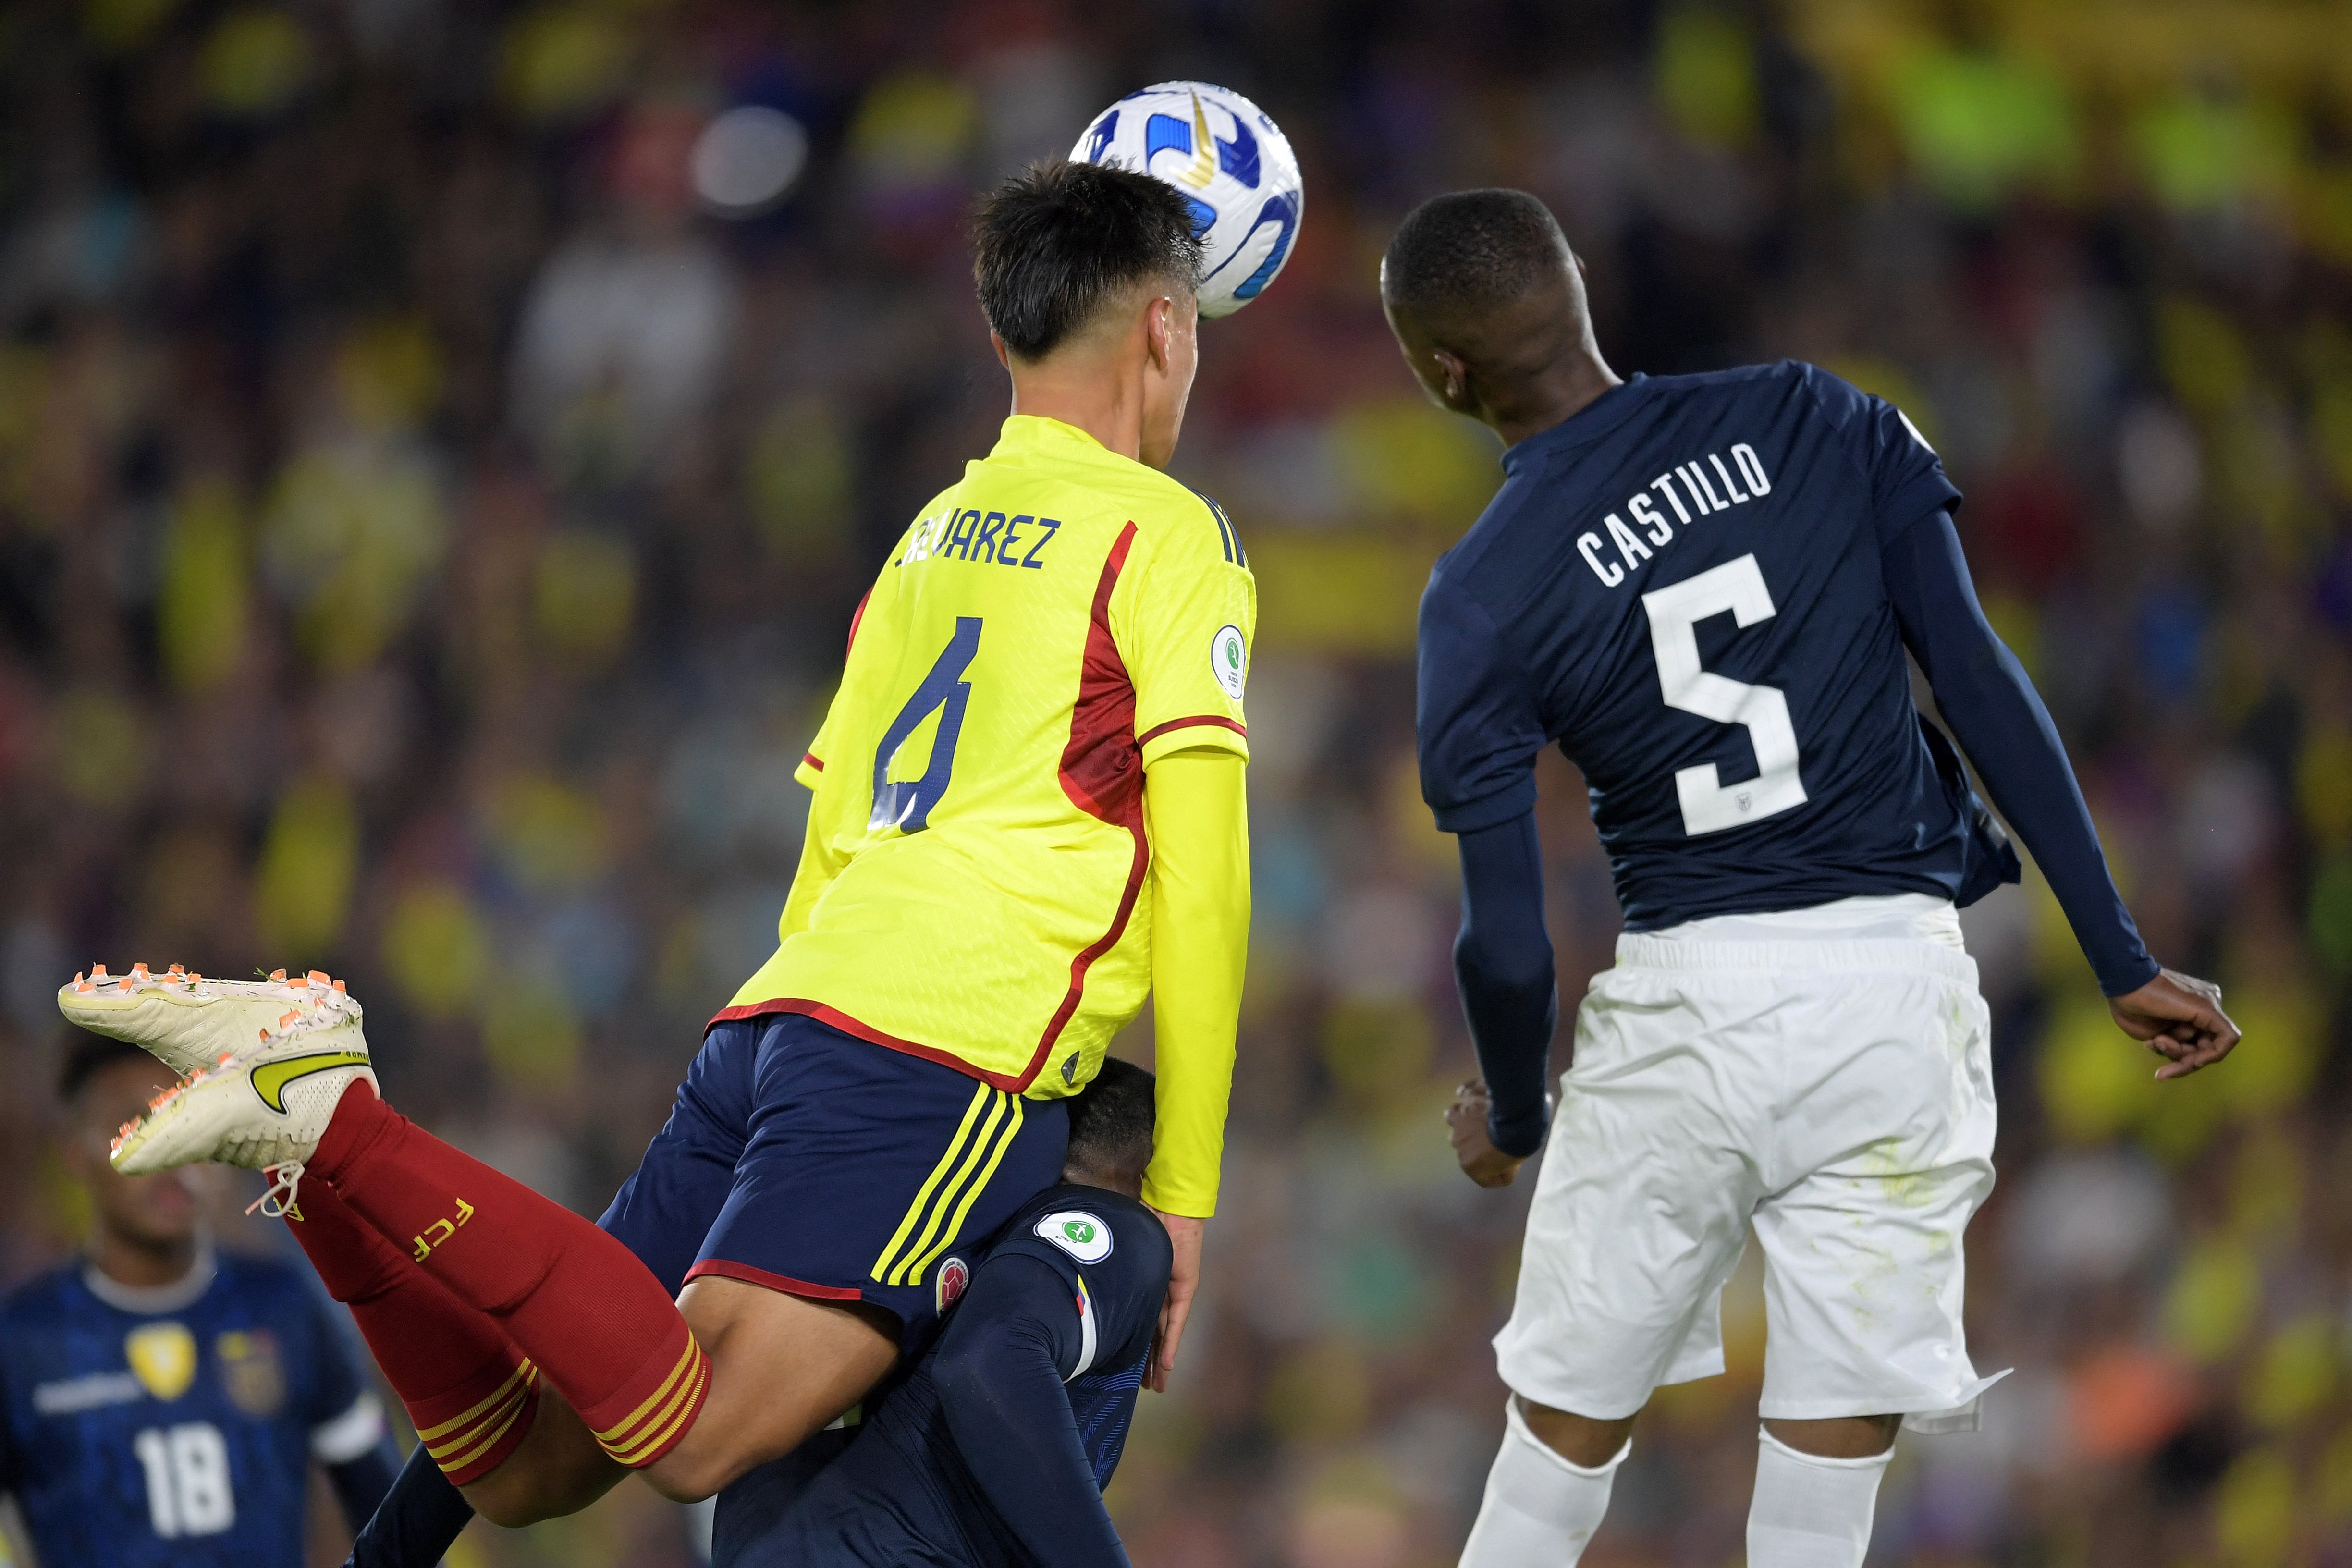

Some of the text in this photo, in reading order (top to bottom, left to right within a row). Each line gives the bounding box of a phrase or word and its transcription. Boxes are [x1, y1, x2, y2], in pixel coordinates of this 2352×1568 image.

[1577, 443, 1772, 588] CASTILLO
[1641, 552, 1808, 836] 5
[413, 1197, 474, 1262] FCF
[134, 1420, 236, 1540] 18
